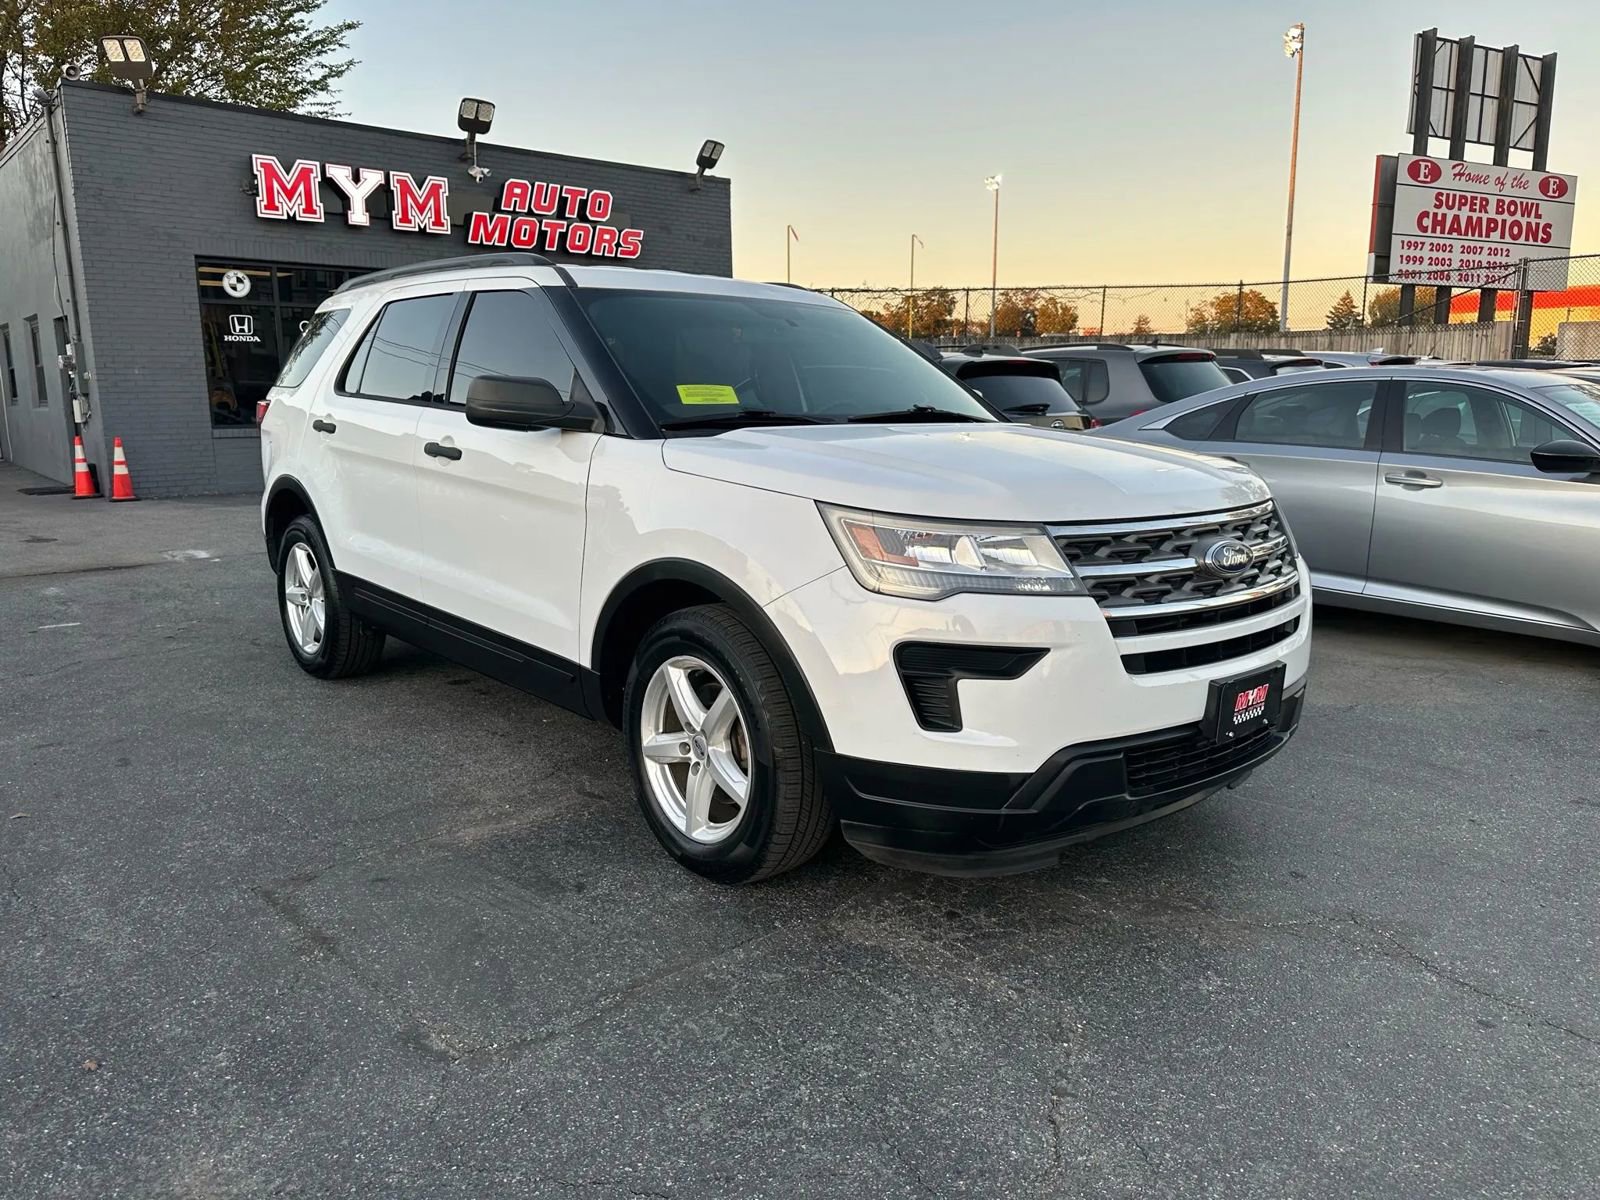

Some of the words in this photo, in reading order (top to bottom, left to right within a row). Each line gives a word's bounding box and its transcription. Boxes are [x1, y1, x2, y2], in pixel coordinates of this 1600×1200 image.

[1417, 161, 1431, 182] E
[1451, 163, 1490, 185] Home
[1494, 171, 1508, 193] of
[1511, 173, 1530, 190] the
[251, 154, 451, 235] MYM
[501, 178, 613, 222] AUTO
[1547, 178, 1560, 197] E
[1433, 191, 1490, 214] SUPER
[1495, 198, 1543, 219] BOWL
[468, 211, 644, 259] MOTORS
[1416, 210, 1553, 244] CHAMPIONS
[1399, 254, 1424, 266] 1999
[1427, 256, 1452, 267] 2003
[1458, 259, 1483, 269] 2010
[1400, 240, 1425, 251] 1997
[1428, 242, 1454, 253] 2002
[1460, 244, 1485, 255] 2007
[1487, 246, 1511, 257] 2012
[1427, 270, 1451, 281] 2006
[1457, 273, 1481, 283] 2011
[1223, 546, 1249, 567] Ford
[1235, 684, 1269, 712] MYM
